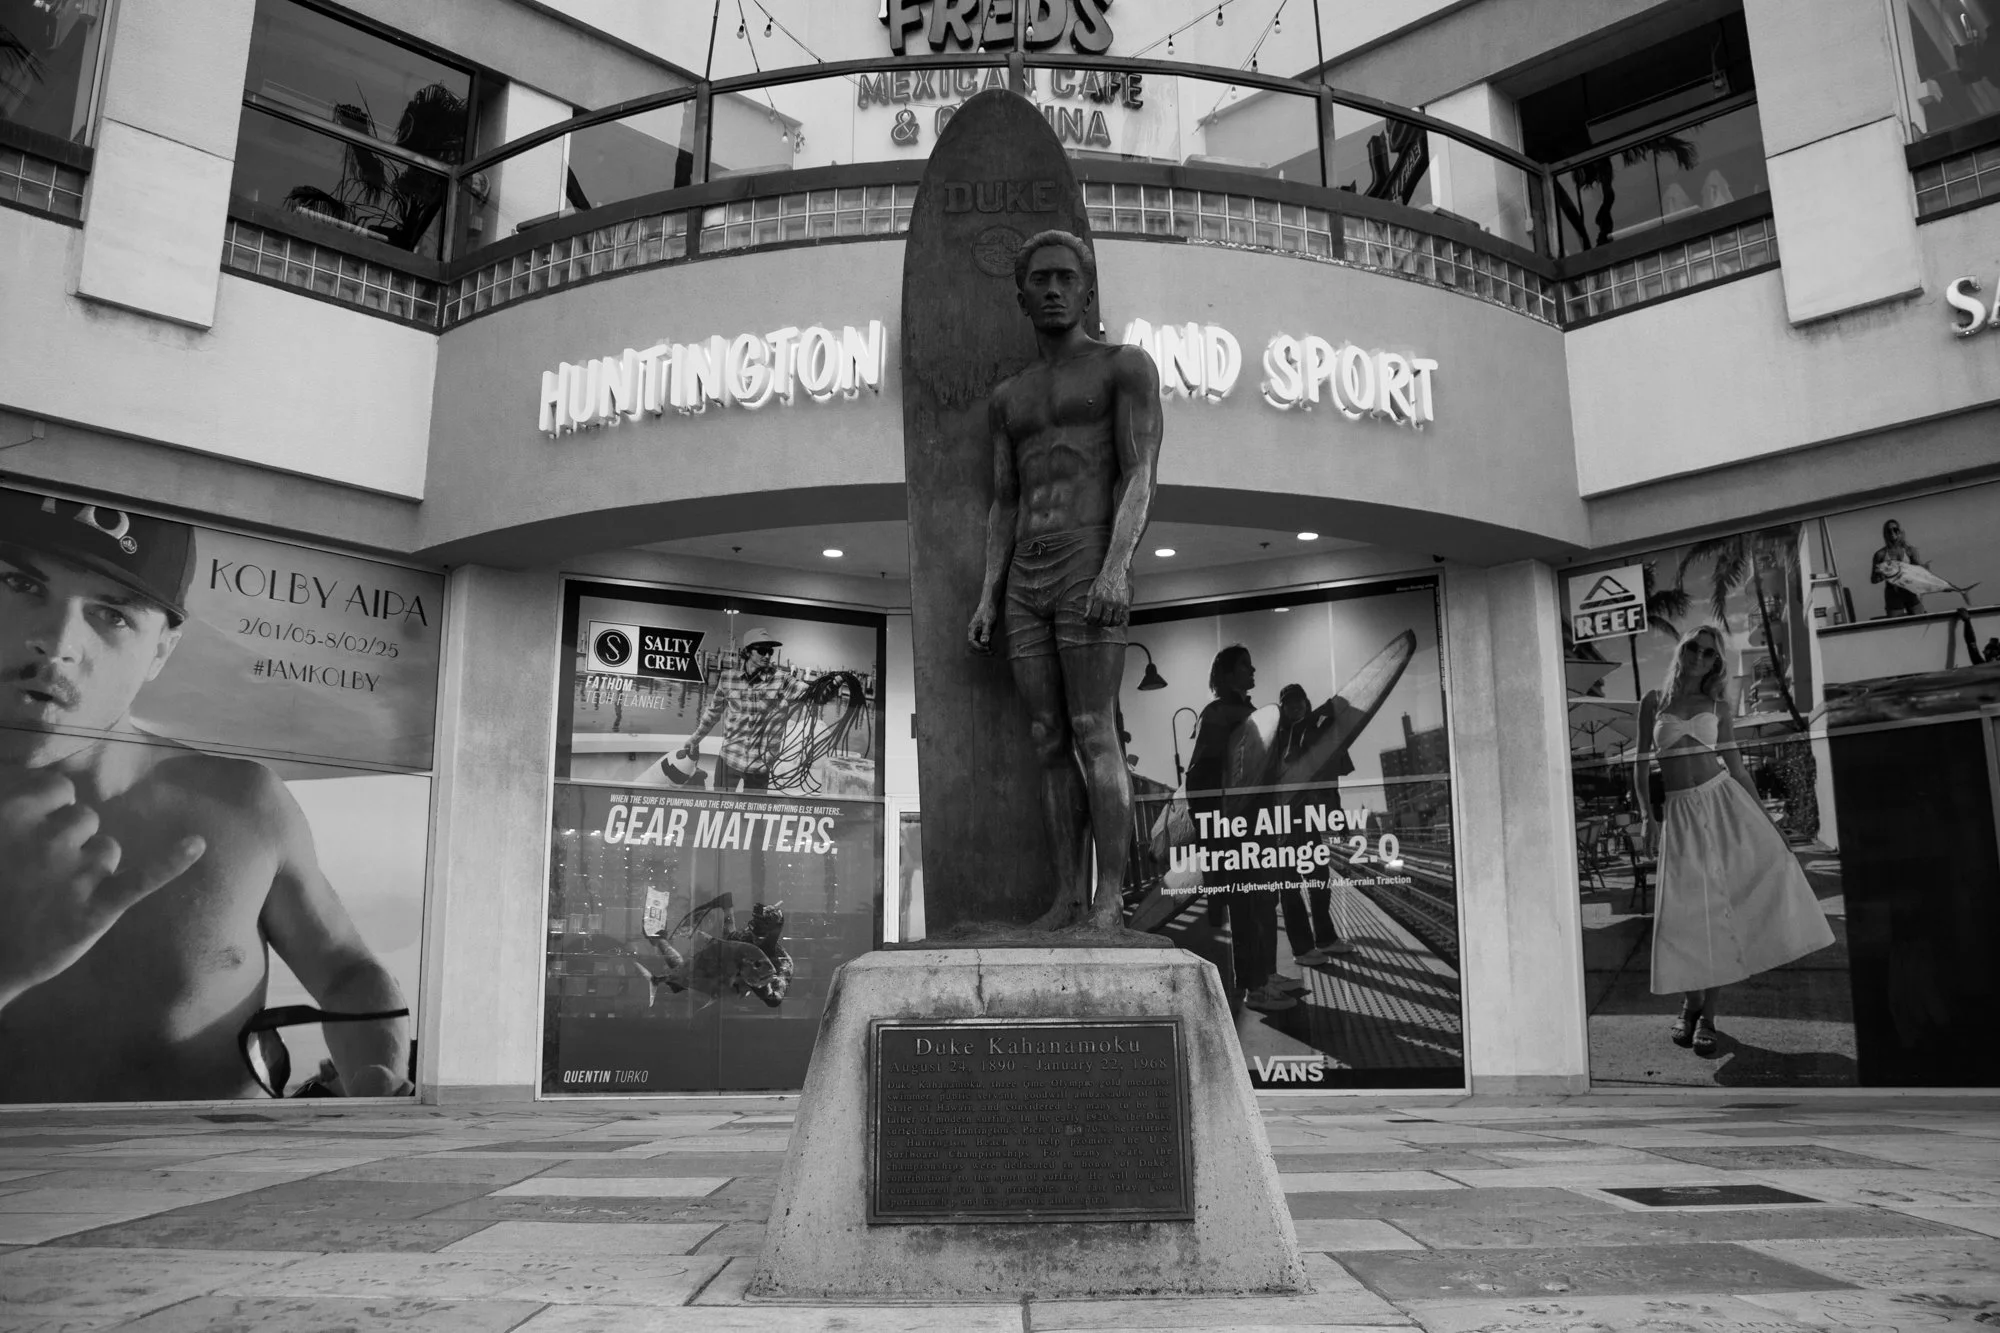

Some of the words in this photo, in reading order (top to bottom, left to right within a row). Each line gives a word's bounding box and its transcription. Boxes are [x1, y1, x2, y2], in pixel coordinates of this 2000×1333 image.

[858, 66, 1035, 110] MEXICAN
[890, 109, 921, 146] &
[944, 180, 1059, 214] DUKE
[539, 318, 886, 436] HUNTINGTON
[1262, 335, 1439, 430] SPORT
[210, 558, 339, 609] KOLBY
[344, 583, 428, 627] AIPA
[238, 617, 399, 659] 2/01/05-8/02/25
[1575, 607, 1643, 638] REEF
[644, 635, 693, 654] SALTY
[253, 659, 381, 692] #IAMKOLBY
[644, 654, 690, 672] CREW
[585, 675, 633, 692] FATHOM
[585, 689, 615, 705] TECH
[616, 692, 667, 711] FLANNEL
[610, 794, 629, 803] WHEN
[629, 795, 643, 804] THE
[642, 796, 659, 805] SURF
[658, 797, 667, 806] IS
[667, 797, 694, 808] PUMPING
[694, 799, 708, 808] AND
[708, 800, 720, 809] THE
[720, 800, 734, 810] FISH
[734, 801, 747, 811] ARE
[747, 802, 767, 811] BITING
[768, 803, 774, 812] &
[773, 803, 799, 814] NOTHING
[799, 805, 813, 814] ELSE
[604, 804, 689, 848] GEAR
[692, 809, 839, 855] MATTERS.
[1195, 809, 1248, 840] The
[1253, 803, 1369, 836] All-New
[1348, 833, 1400, 866] 2.0
[1161, 885, 1197, 897] Improved
[1197, 883, 1231, 895] Support
[1236, 879, 1284, 894] Lightweight
[1284, 878, 1326, 891] Durability
[1331, 876, 1375, 888] All-Terrain
[1375, 874, 1412, 886] Traction
[916, 1037, 975, 1056] Duke
[989, 1035, 1141, 1055] Kahanamoku
[563, 1070, 611, 1084] QUENTIN
[614, 1070, 649, 1083] TURKO
[889, 1061, 942, 1076] August
[950, 1060, 972, 1073] 24,
[981, 1059, 1016, 1073] 1890
[1036, 1059, 1092, 1074] January
[1101, 1058, 1124, 1072] 22,
[1133, 1057, 1168, 1071] 1968
[1253, 1055, 1325, 1083] VANS
